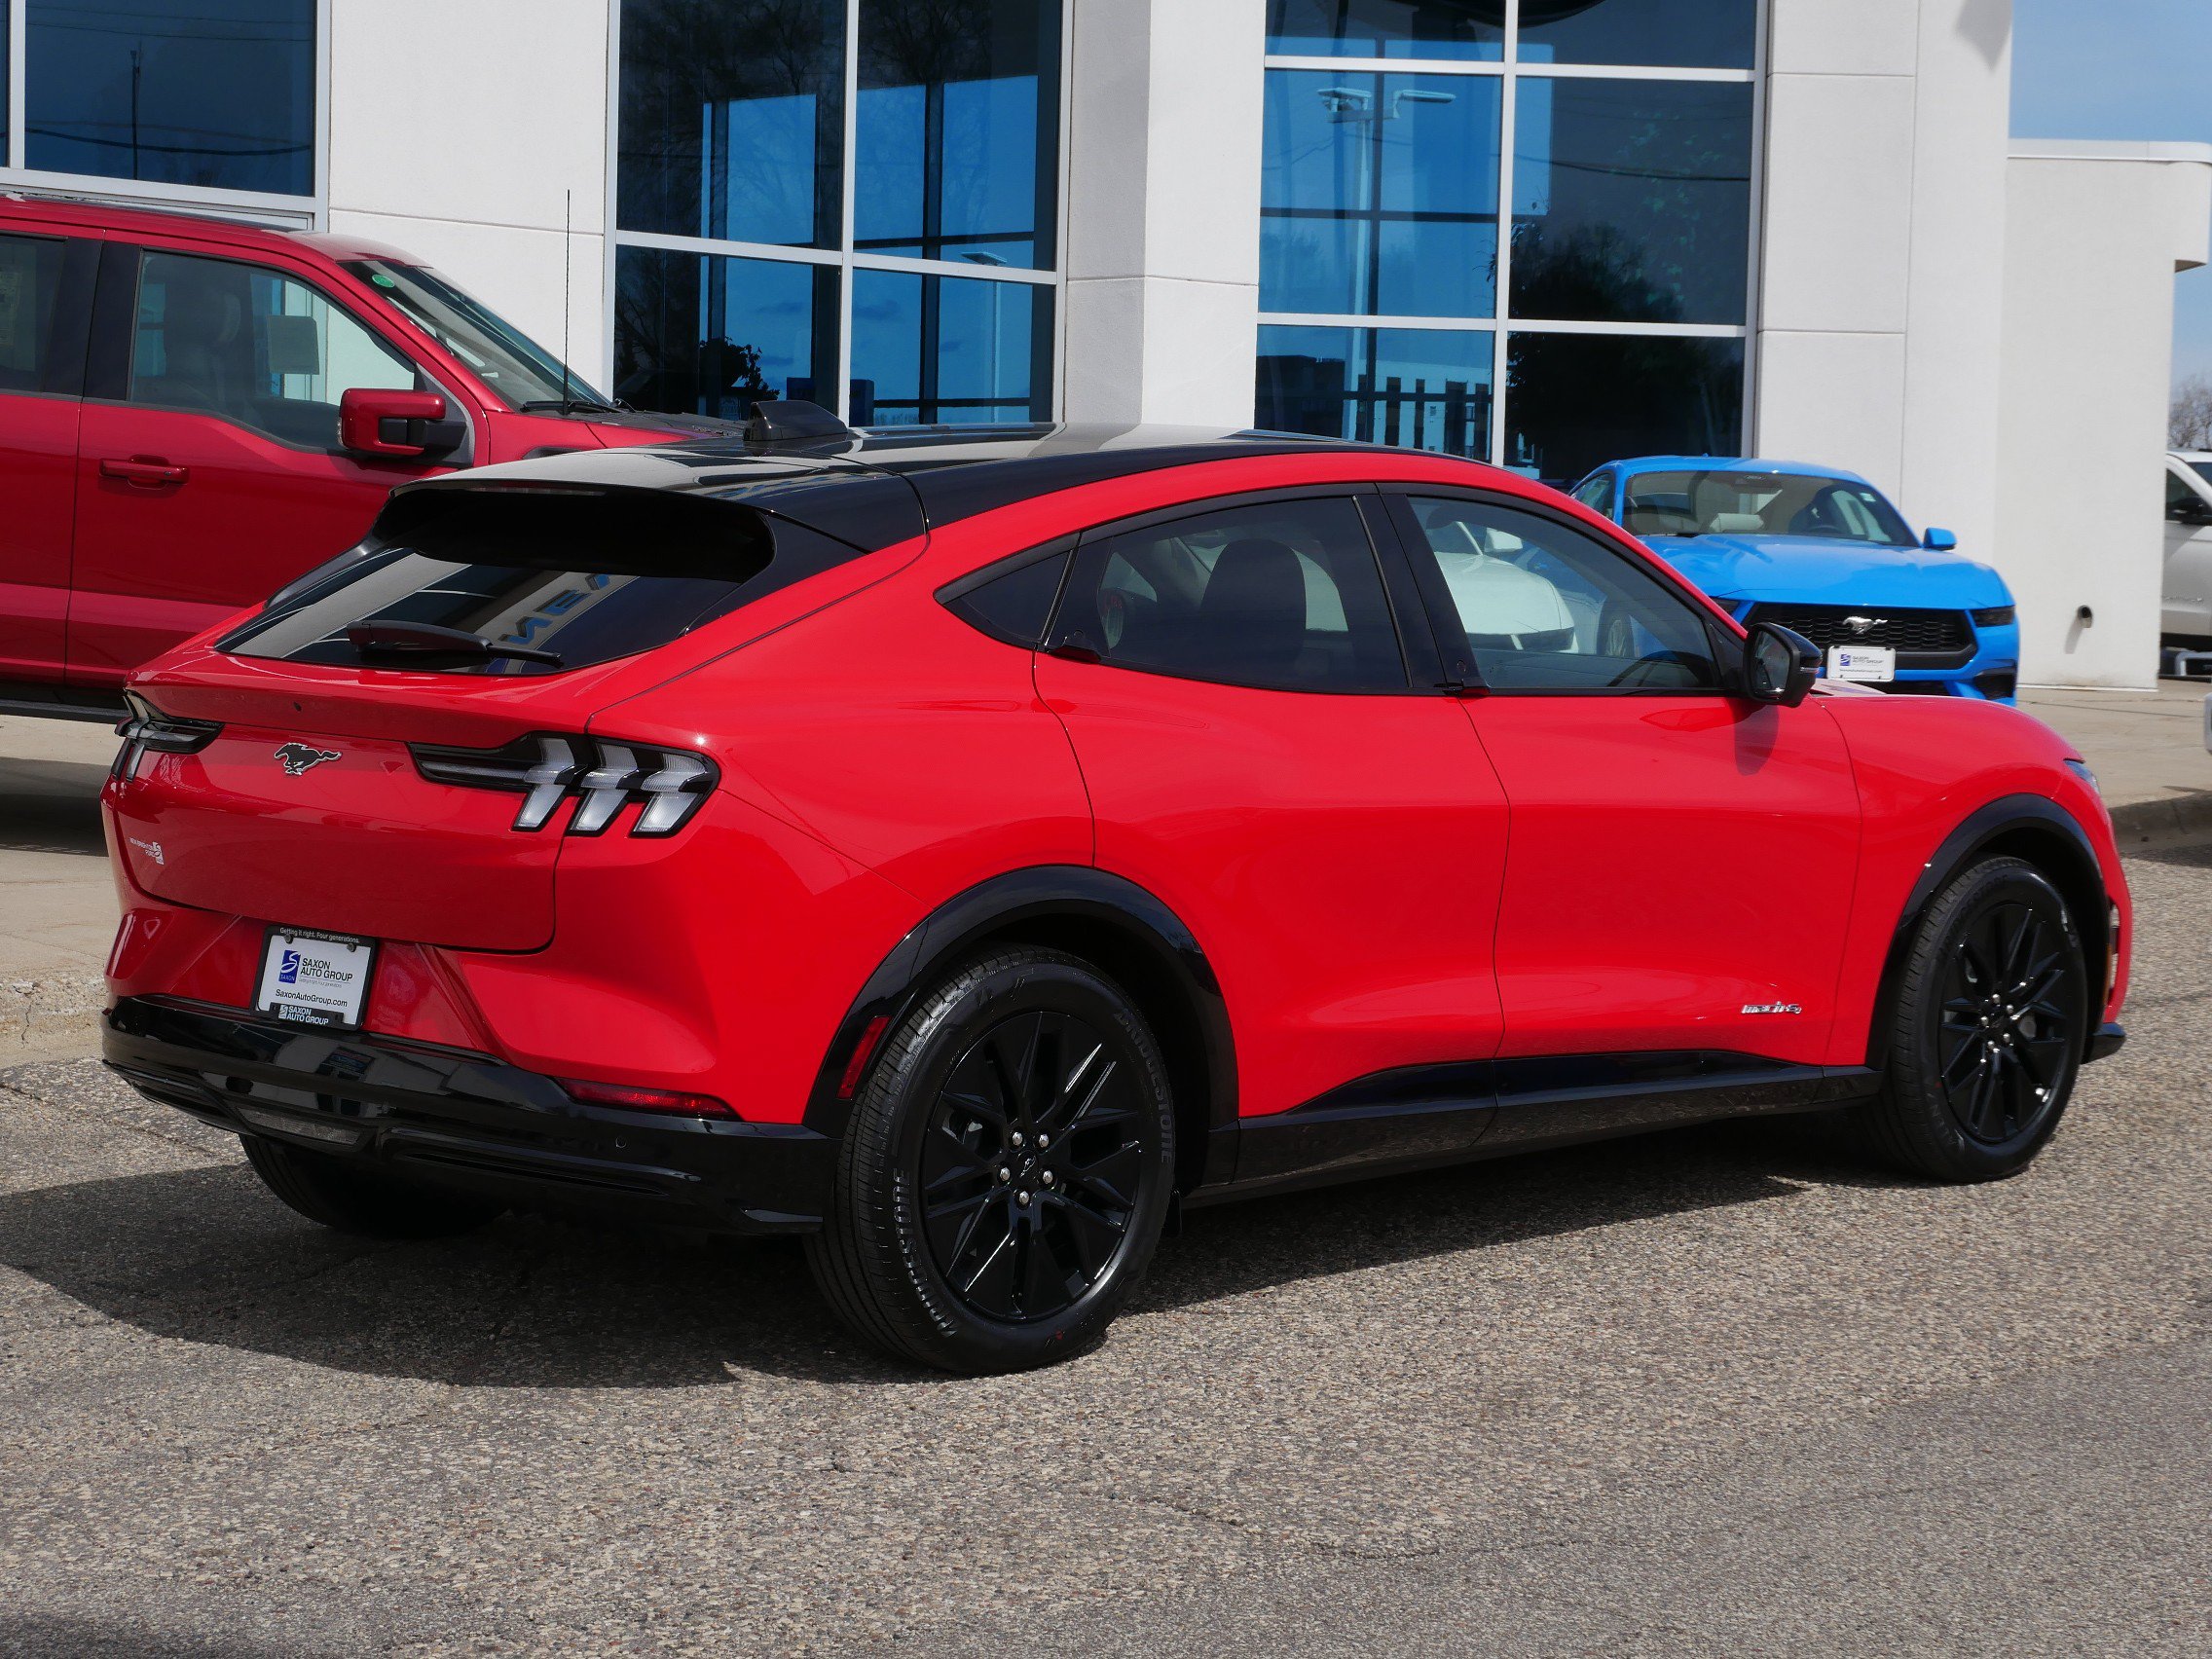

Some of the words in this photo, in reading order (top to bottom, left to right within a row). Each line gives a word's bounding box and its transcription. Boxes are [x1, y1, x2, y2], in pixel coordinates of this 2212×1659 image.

[279, 927, 298, 937] Getting
[328, 934, 360, 943] generations.
[302, 958, 330, 970] SAXON
[300, 967, 322, 977] AUTO
[323, 971, 353, 982] GROUP
[275, 988, 348, 1007] SaxonAutoGroup.com
[288, 1005, 312, 1015] SAXON
[286, 1013, 305, 1022] AUTO
[305, 1015, 329, 1025] GROUP
